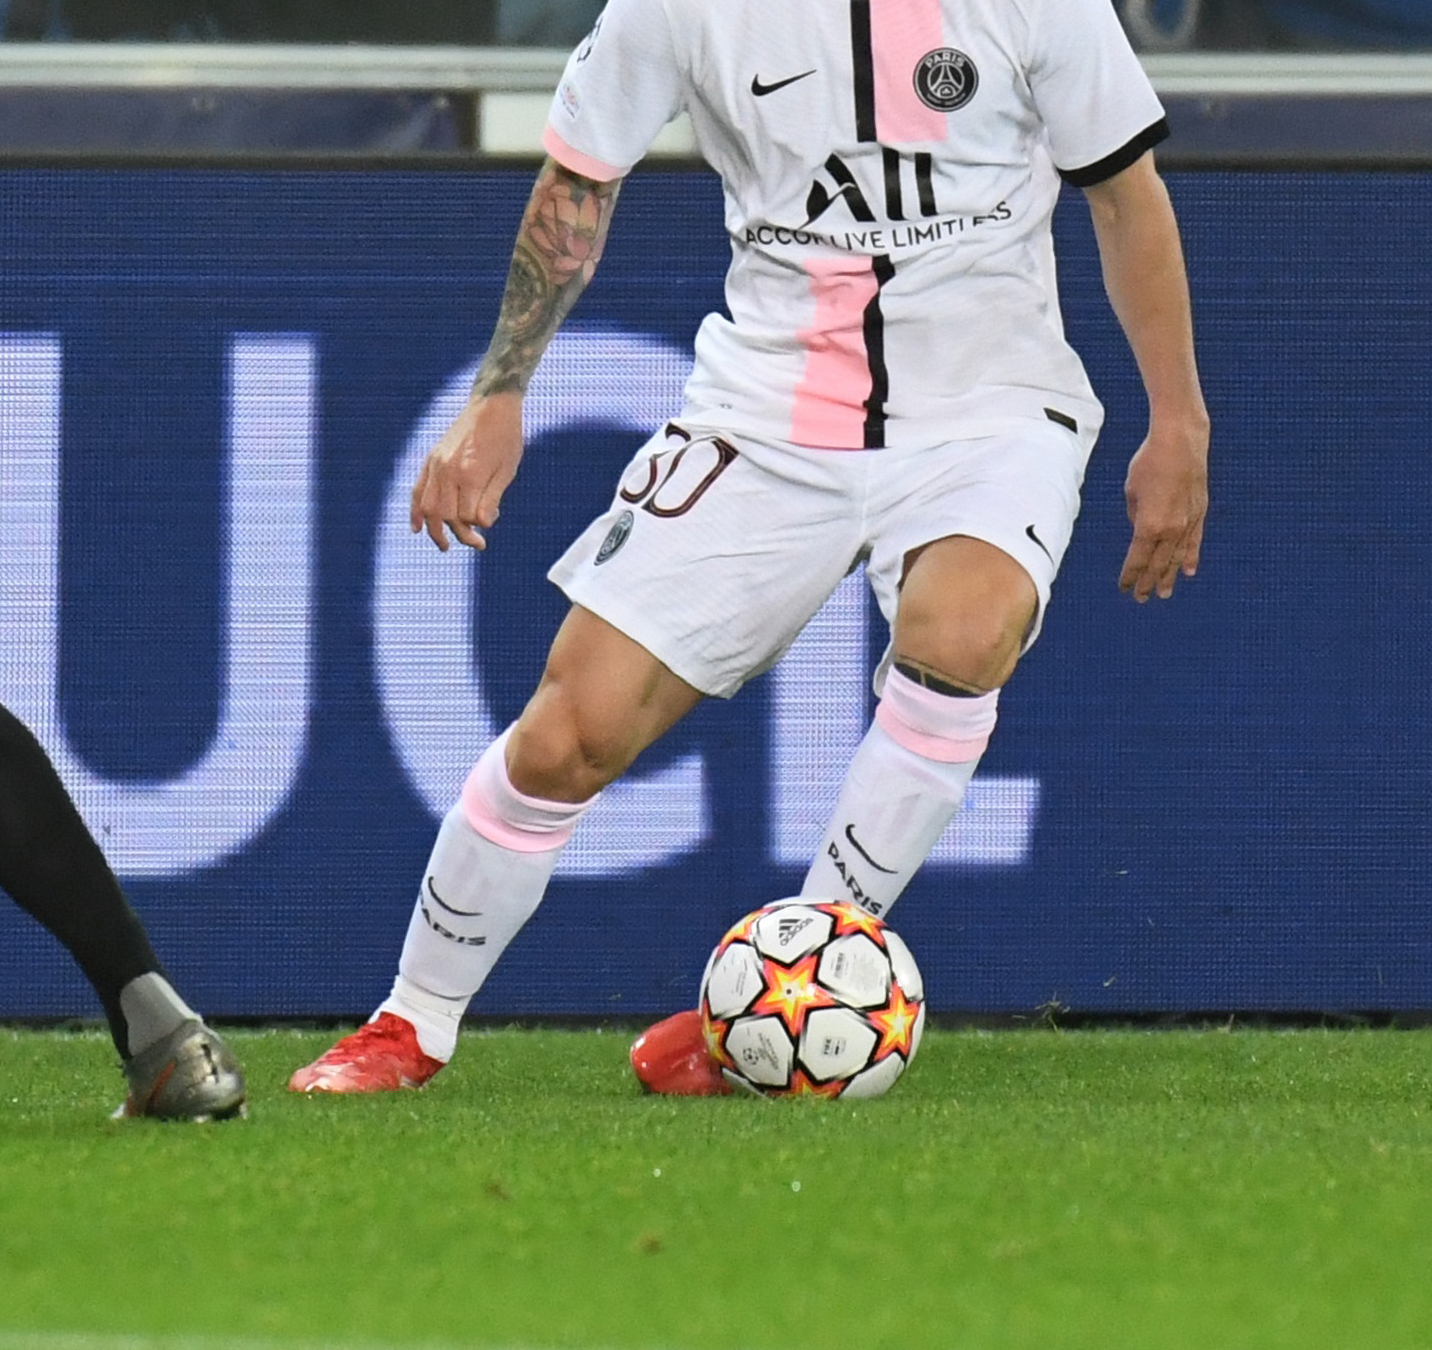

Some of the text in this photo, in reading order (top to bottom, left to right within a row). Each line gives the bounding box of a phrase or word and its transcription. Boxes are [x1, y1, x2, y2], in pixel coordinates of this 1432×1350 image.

[924, 52, 966, 68] PARIS
[620, 421, 740, 518] 30
[827, 841, 883, 915] PARIS
